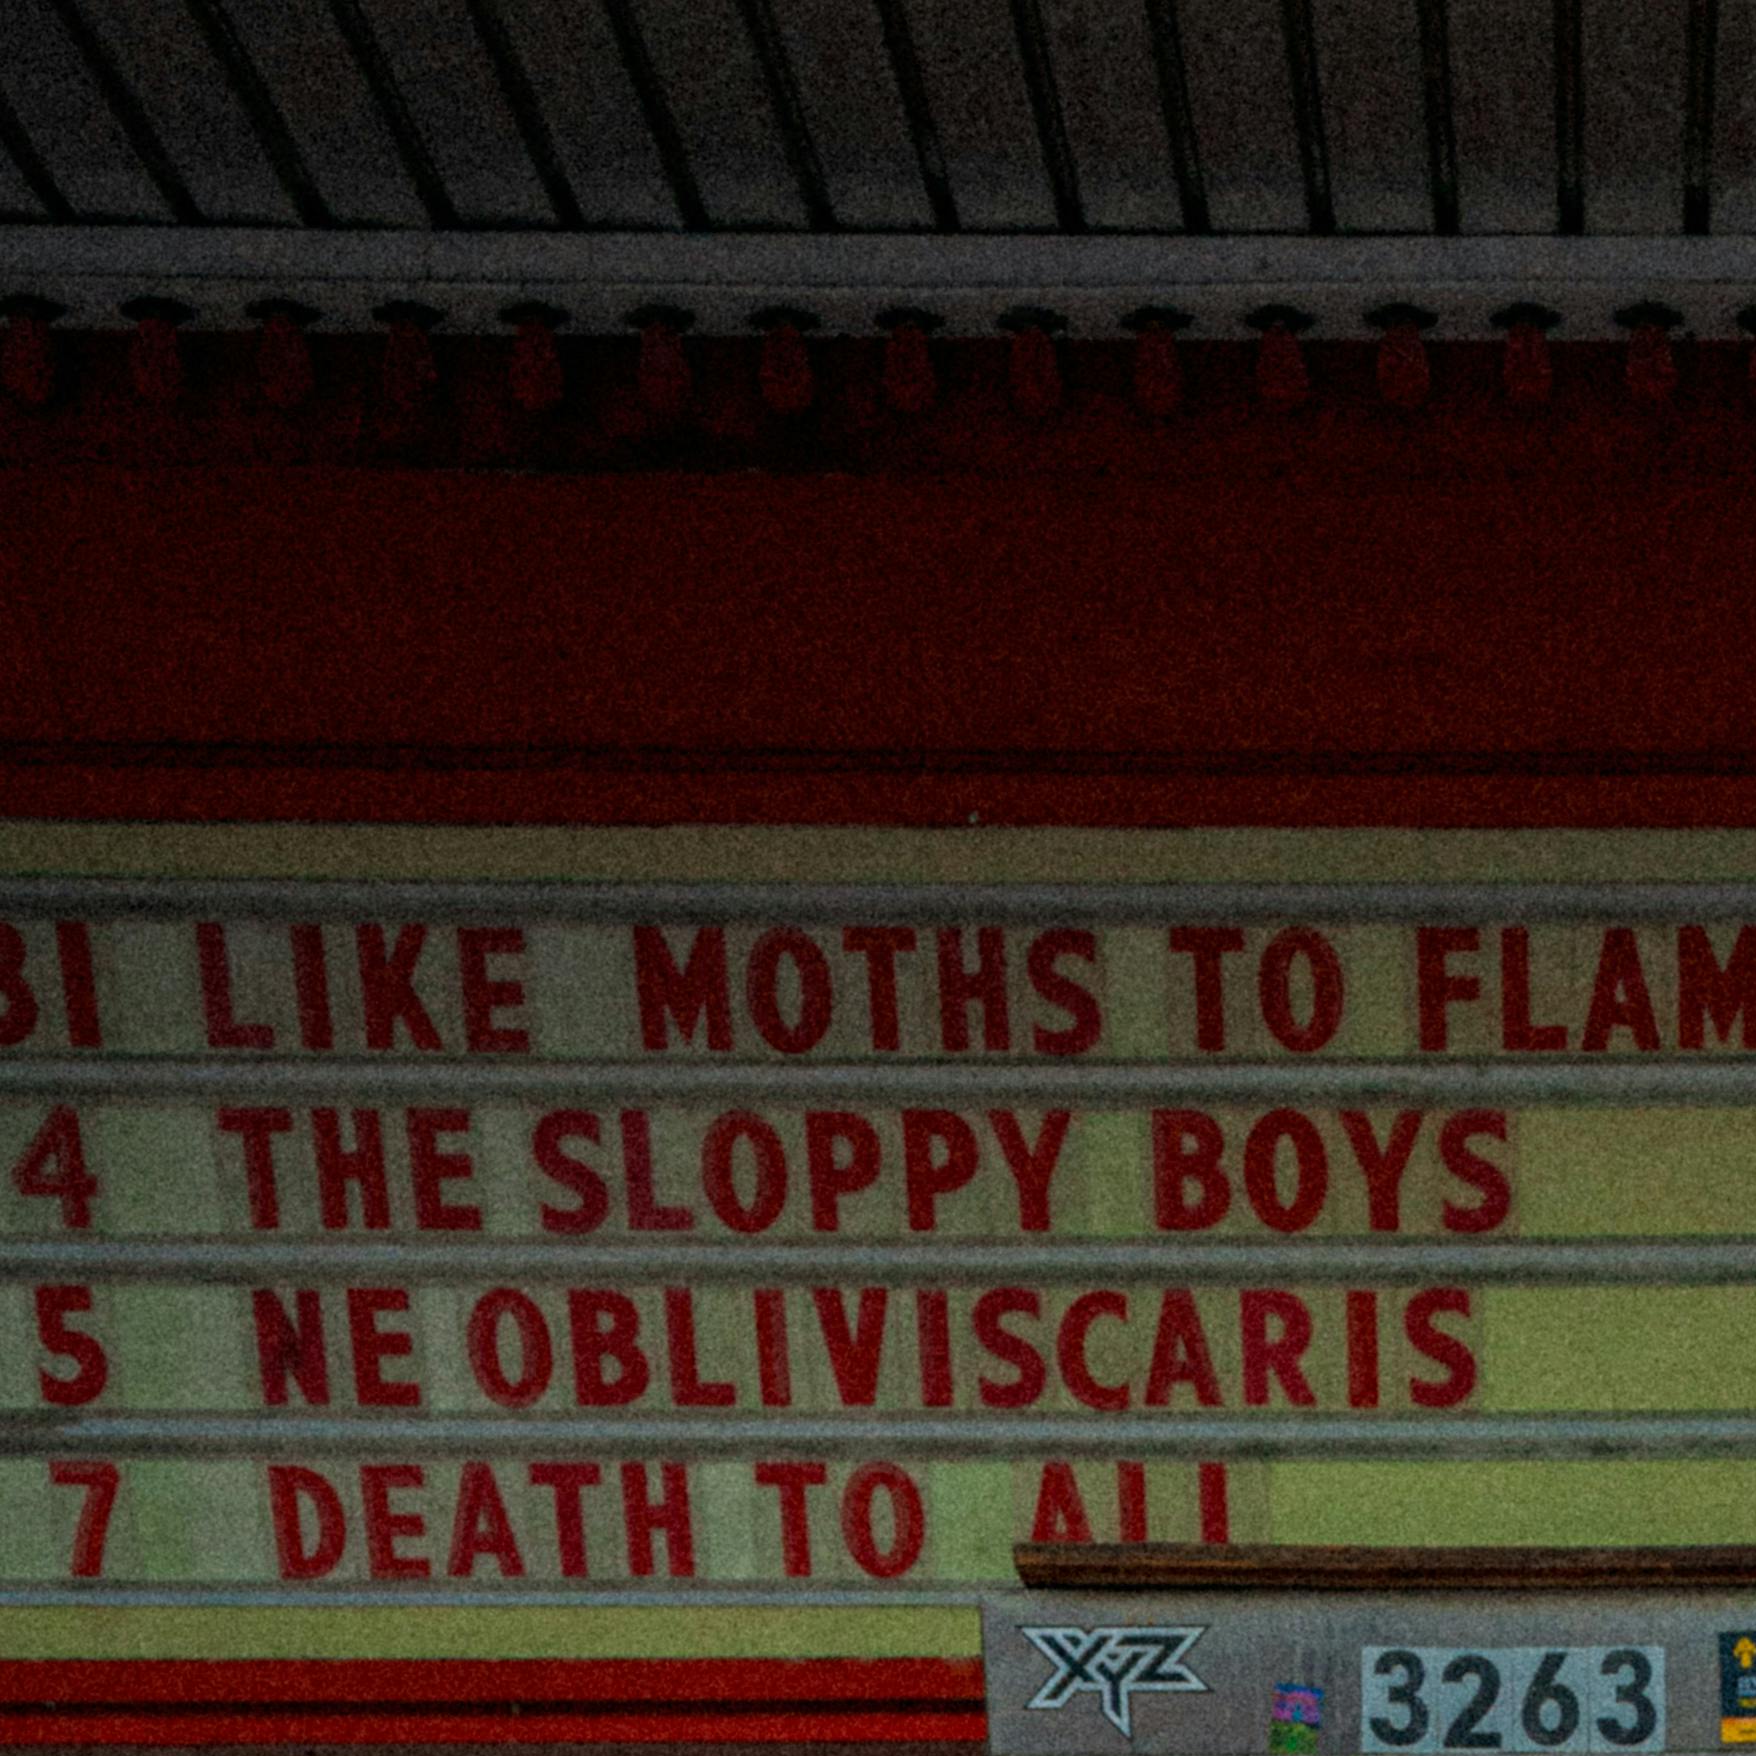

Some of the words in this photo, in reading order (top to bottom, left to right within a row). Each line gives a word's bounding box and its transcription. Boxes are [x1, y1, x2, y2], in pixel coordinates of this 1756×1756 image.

[197, 923, 529, 1052] LIKE
[633, 924, 1103, 1056] MOTHS
[1170, 925, 1344, 1053] TO
[16, 1105, 98, 1230] 4
[218, 1107, 482, 1231] THE
[532, 1108, 1072, 1234] SLOPPY
[1151, 1108, 1512, 1234] BOYS
[35, 1285, 108, 1406] 5
[253, 1288, 421, 1407] NE
[467, 1286, 1477, 1411] OBLIVISCARIS
[51, 1461, 120, 1577] 7
[269, 1462, 696, 1579] DEATH
[755, 1462, 925, 1579] TO
[1369, 1650, 1657, 1748] 3263
